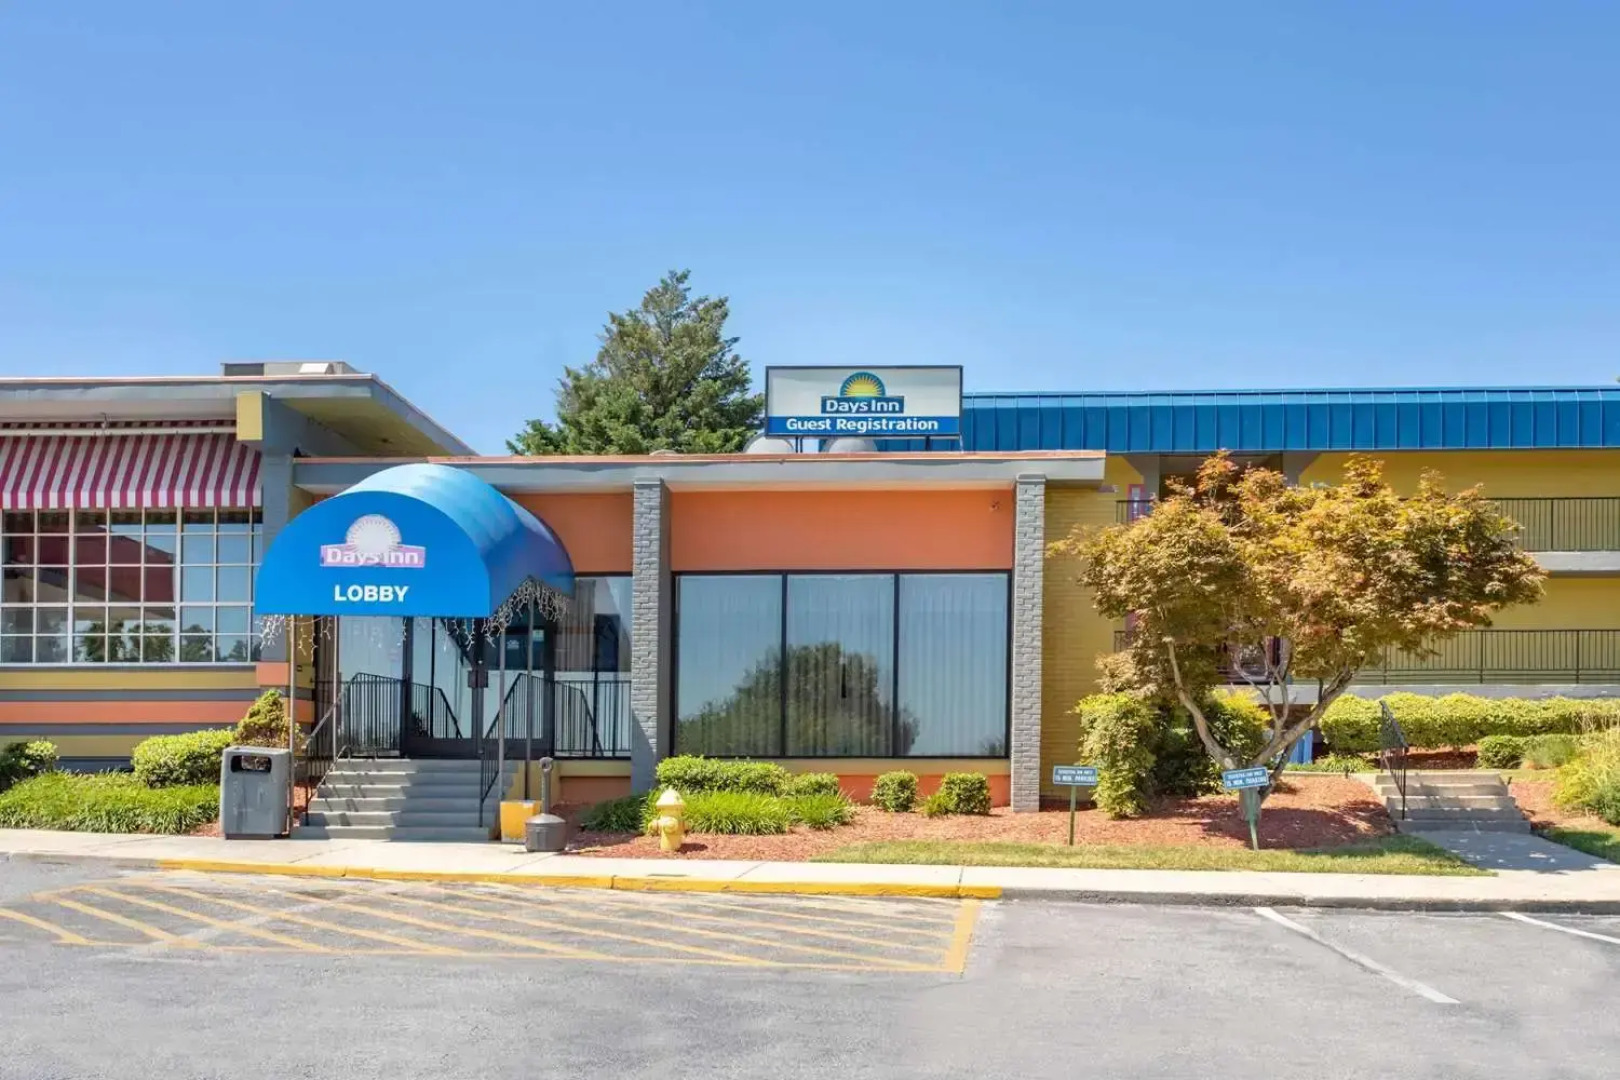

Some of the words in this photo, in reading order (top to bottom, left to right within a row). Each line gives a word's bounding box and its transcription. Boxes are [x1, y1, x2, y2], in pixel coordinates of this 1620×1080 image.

[825, 399, 869, 414] Days
[871, 400, 900, 412] Inn
[786, 418, 832, 430] Guest
[836, 417, 939, 433] Registration
[326, 547, 380, 566] Days
[383, 550, 419, 565] Inn
[334, 584, 409, 602] LOBBY
